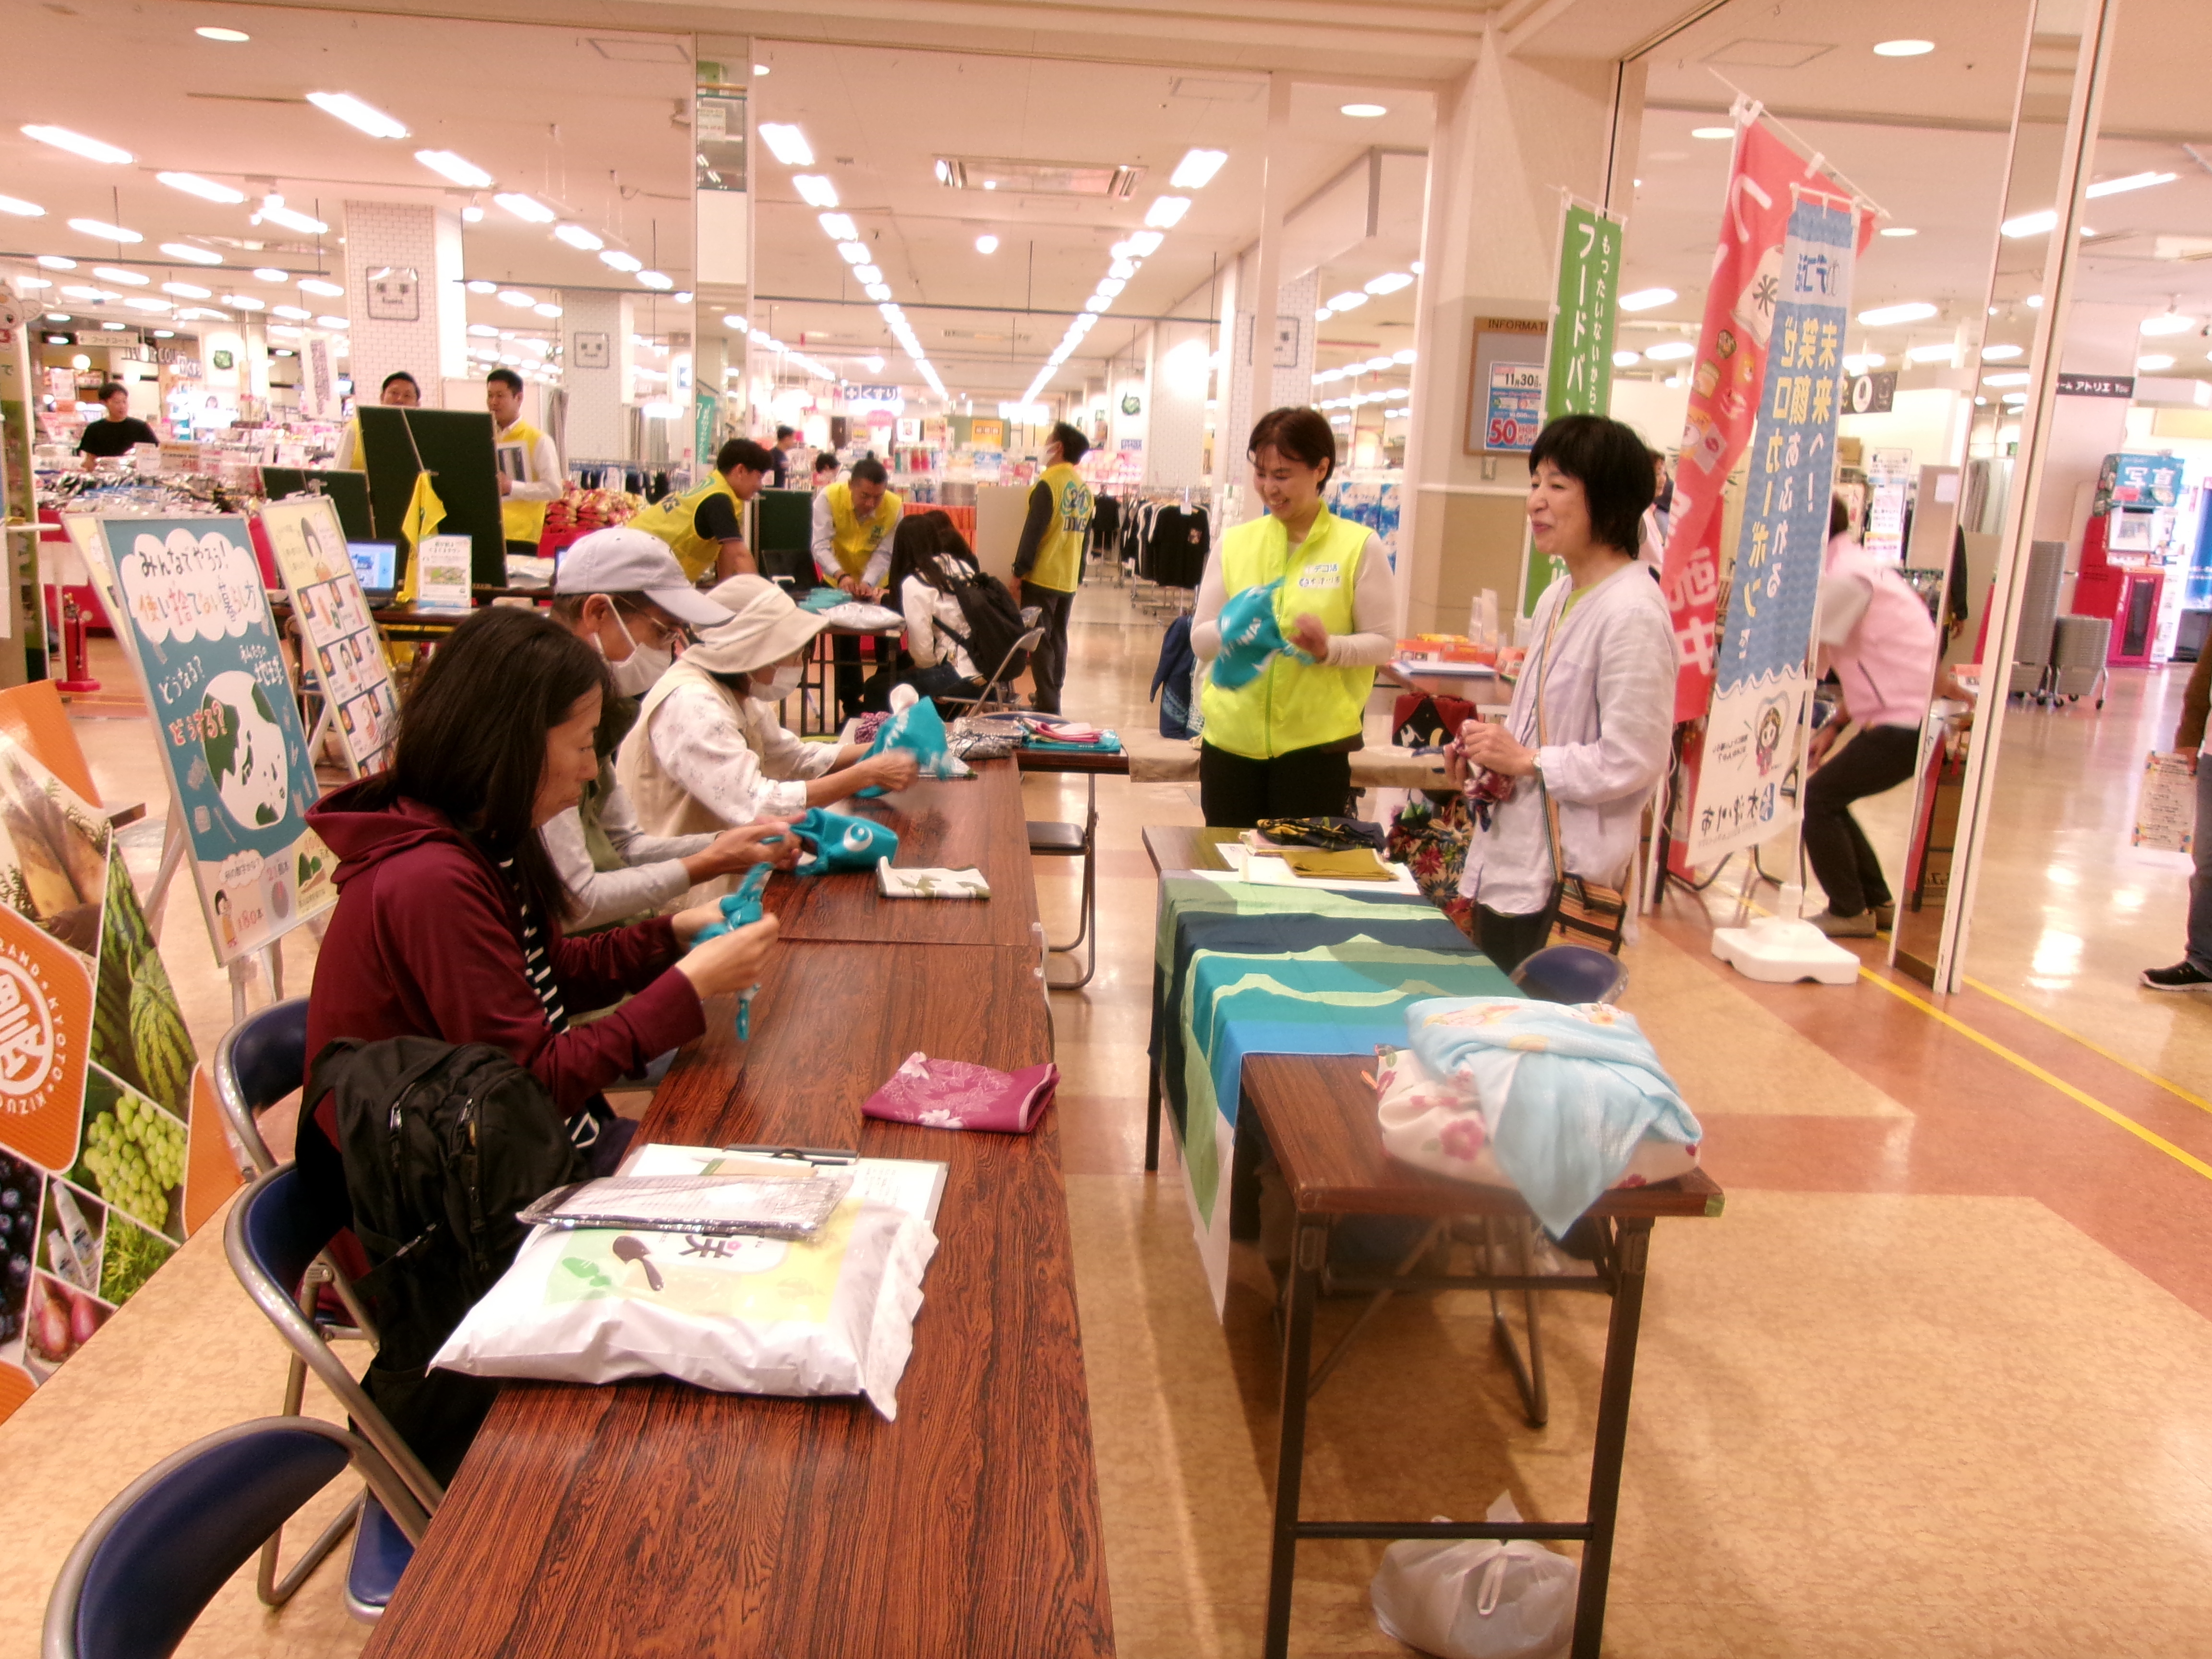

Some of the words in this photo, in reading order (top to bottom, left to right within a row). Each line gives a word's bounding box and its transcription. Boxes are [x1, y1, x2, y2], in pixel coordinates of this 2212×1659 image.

[1589, 234, 1610, 413] もったいないから
[863, 387, 897, 401] くすり
[2075, 381, 2111, 392] アトリエ
[1489, 418, 1518, 445] 50
[2124, 467, 2175, 489] 写真
[1314, 564, 1337, 573] デコ活
[48, 997, 66, 1081] KYOTO
[0, 1091, 47, 1115] KIZU
